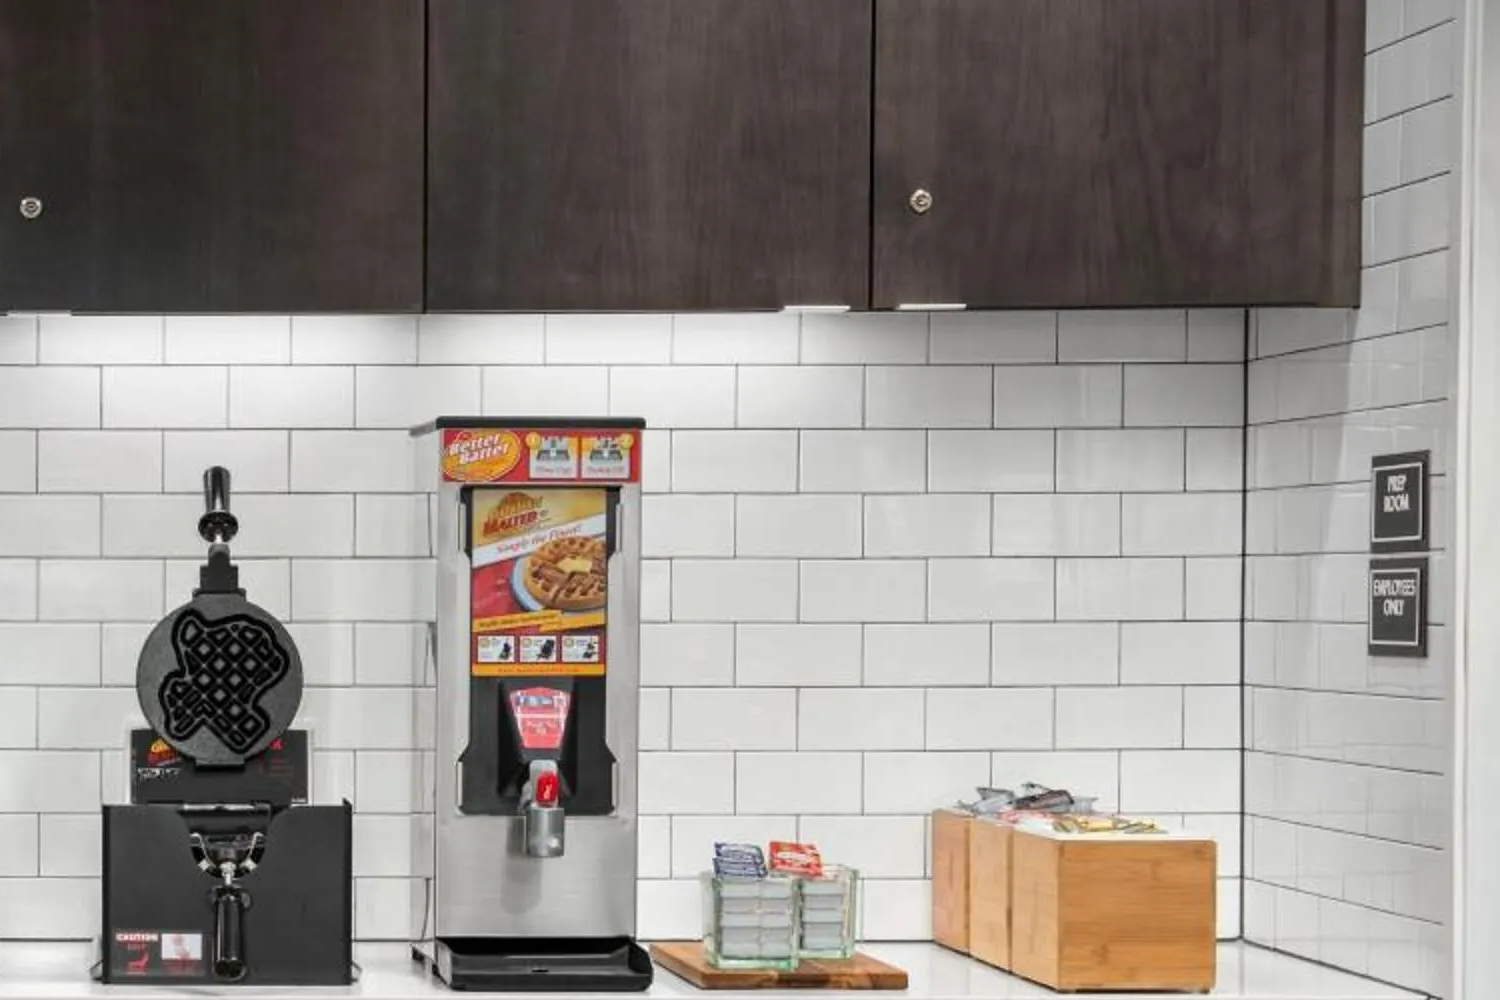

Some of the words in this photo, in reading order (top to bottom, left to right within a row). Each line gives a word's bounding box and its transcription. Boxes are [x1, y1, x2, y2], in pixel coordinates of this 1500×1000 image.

[1386, 475, 1408, 494] PREP
[1383, 494, 1410, 512] ROOM
[1373, 579, 1416, 597] EMPLOYEES
[1383, 599, 1405, 616] ONLY
[115, 933, 159, 942] CAUTION
